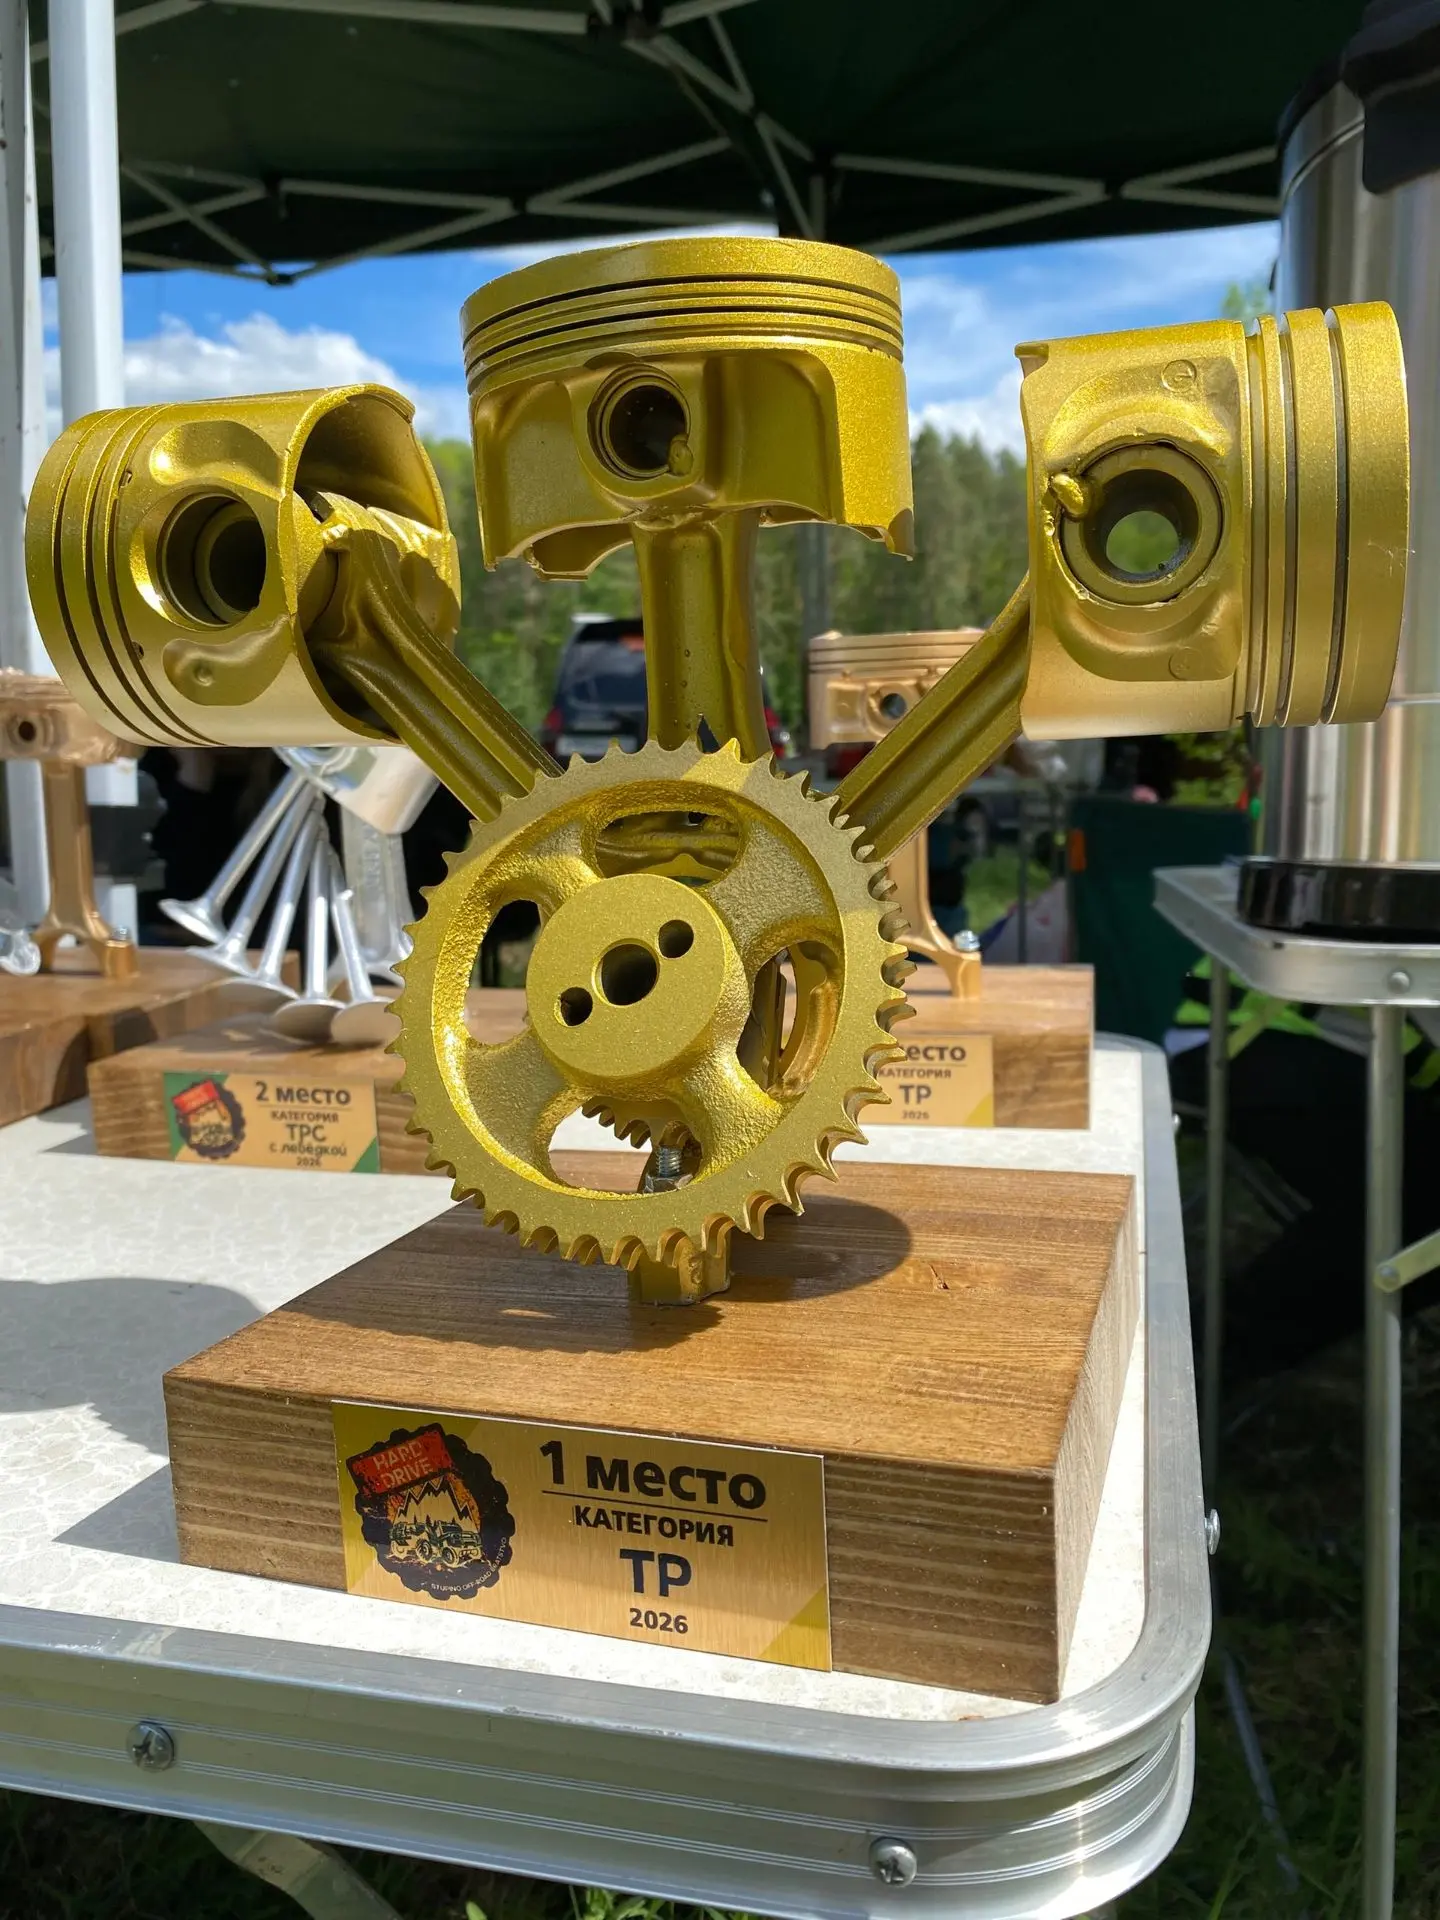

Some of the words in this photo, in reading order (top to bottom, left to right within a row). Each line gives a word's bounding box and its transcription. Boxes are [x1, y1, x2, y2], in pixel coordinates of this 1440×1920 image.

[900, 1044, 966, 1061] есто
[879, 1068, 951, 1078] КАТЕГОРИЯ
[255, 1081, 269, 1102] 2
[277, 1086, 351, 1105] место
[899, 1084, 931, 1104] ТР
[270, 1110, 339, 1122] КАТЕГОРИЯ
[287, 1124, 326, 1141] ТРС
[372, 1440, 423, 1471] HARD
[381, 1458, 434, 1489] DRIVE
[540, 1440, 565, 1485] 1
[587, 1456, 766, 1510] место
[575, 1505, 734, 1547] КАТЕГОРИЯ
[620, 1549, 692, 1597] ТР
[630, 1608, 689, 1634] 2026
